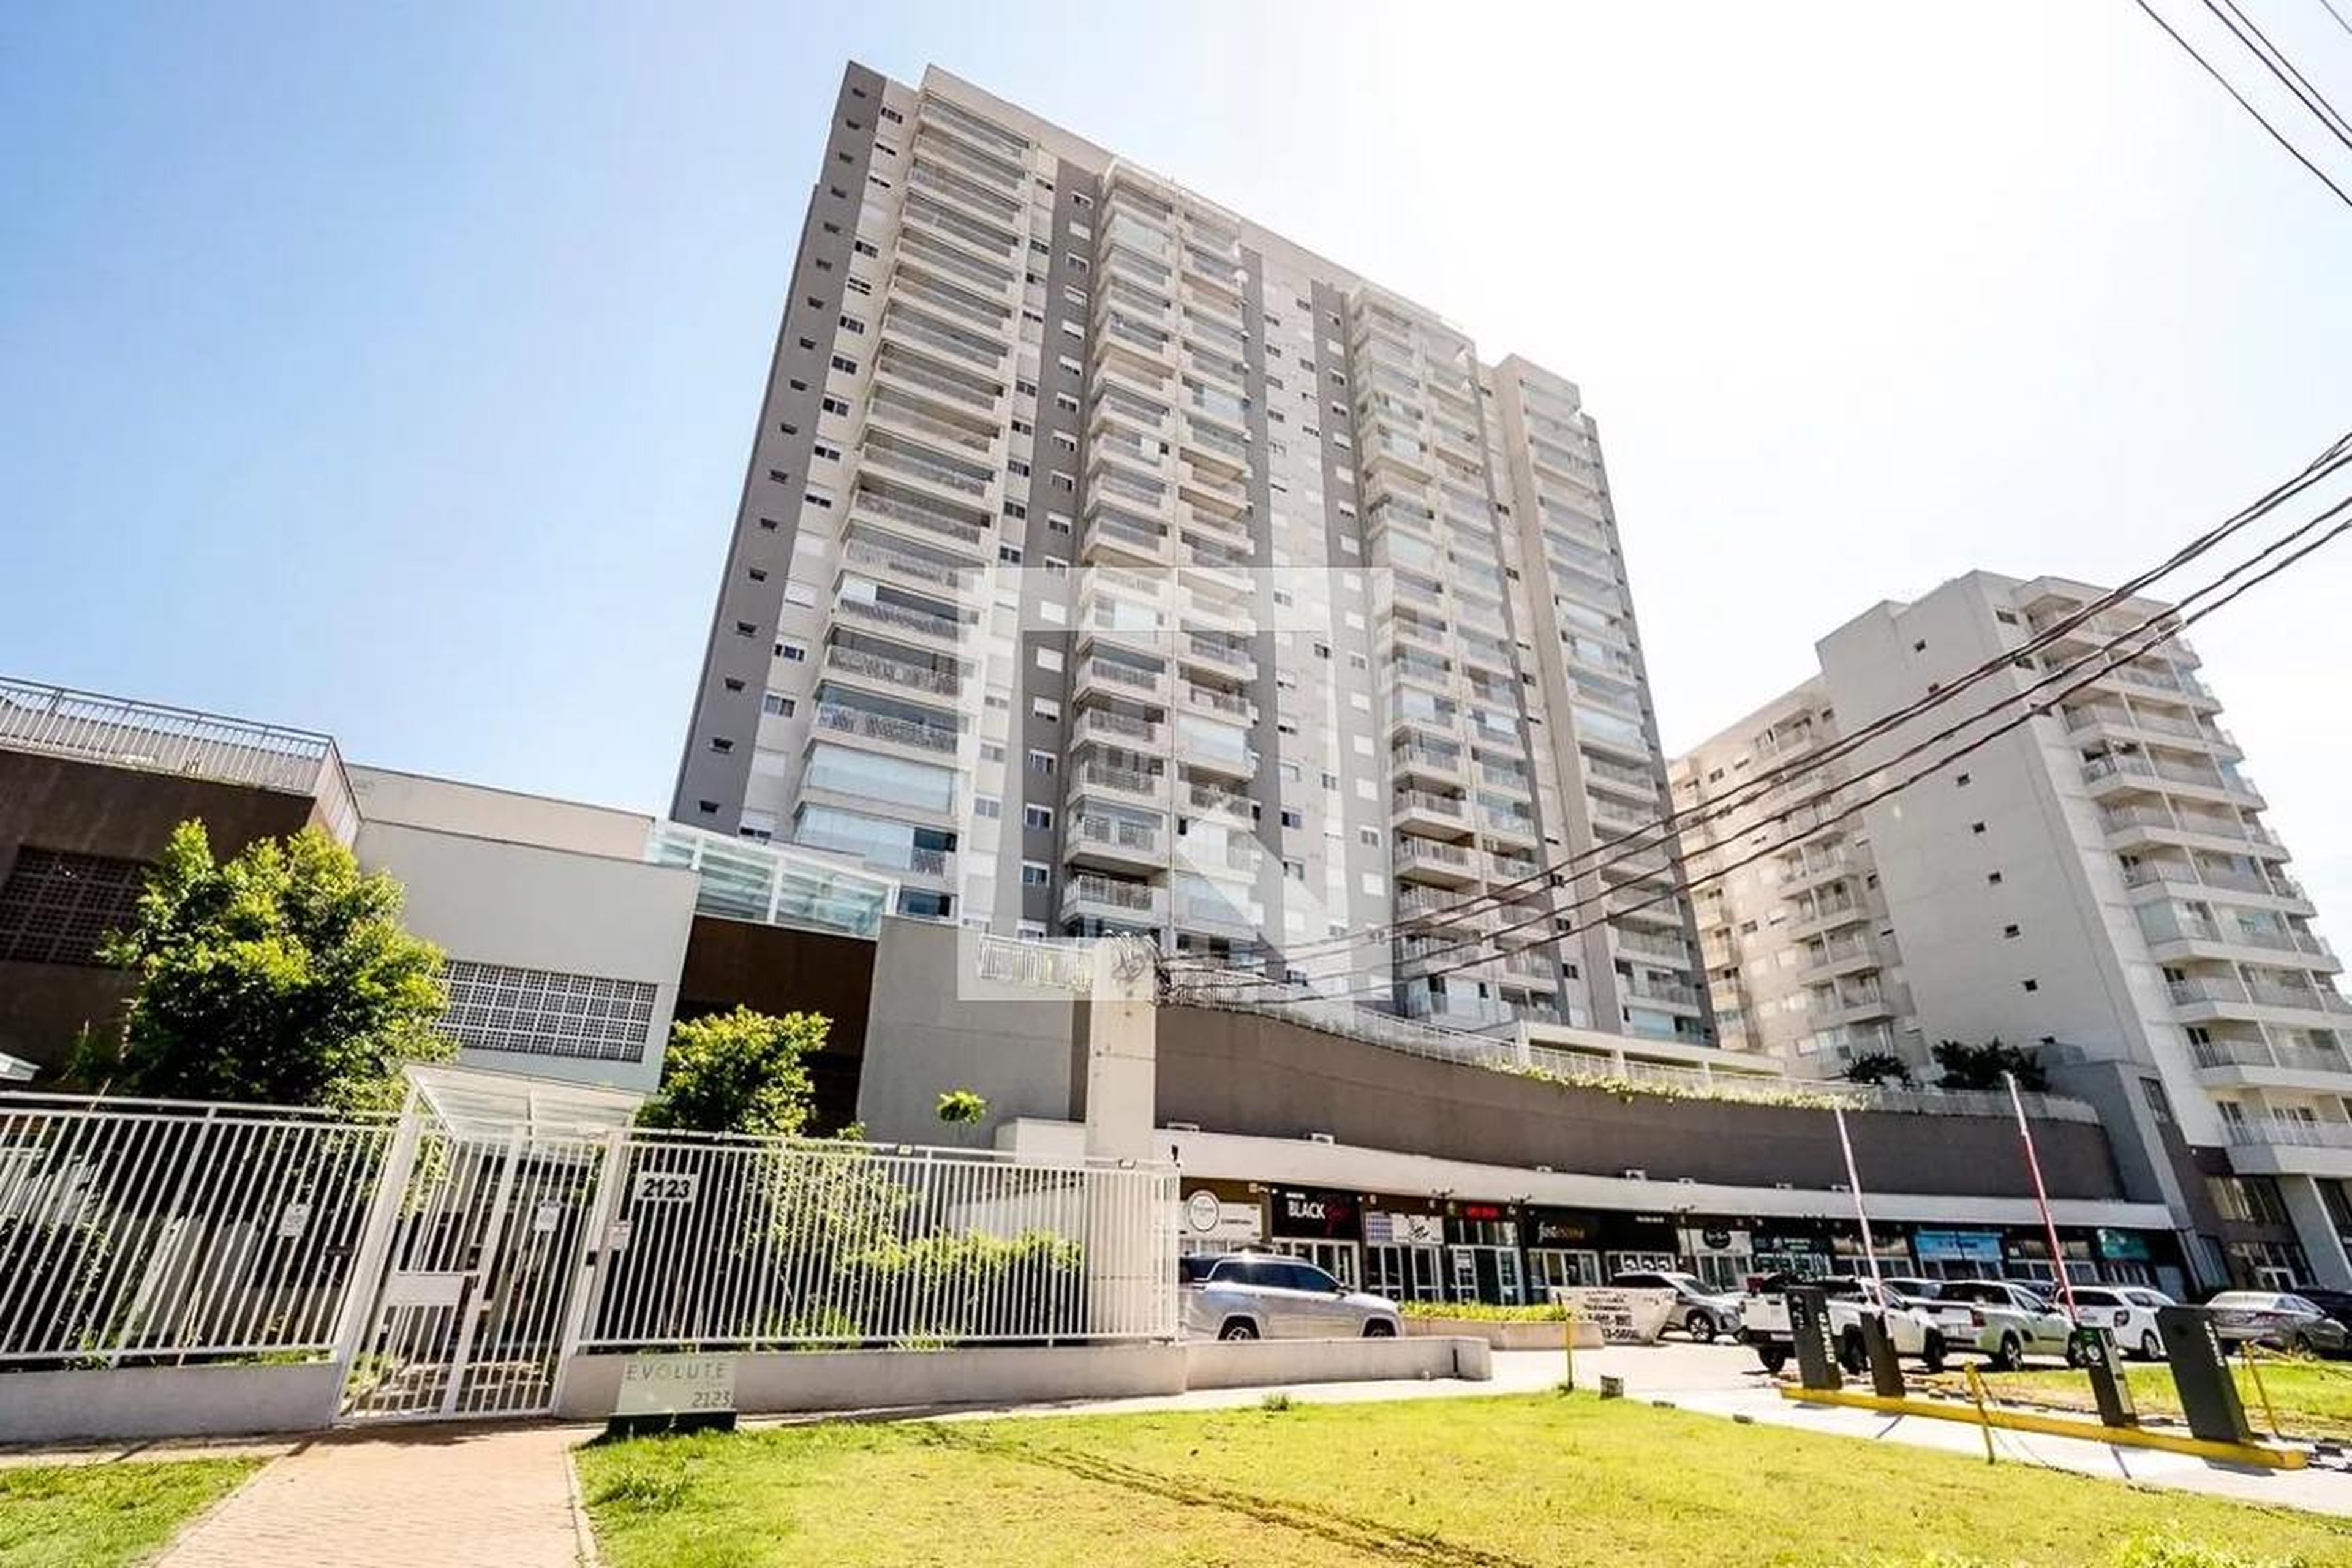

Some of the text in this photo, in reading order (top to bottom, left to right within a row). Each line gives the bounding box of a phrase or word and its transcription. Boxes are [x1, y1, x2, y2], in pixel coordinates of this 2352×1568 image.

[642, 1178, 690, 1198] 2123
[1287, 1200, 1325, 1220] BLACK
[627, 1362, 726, 1381] EVOLUTE
[692, 1391, 731, 1408] 2123
